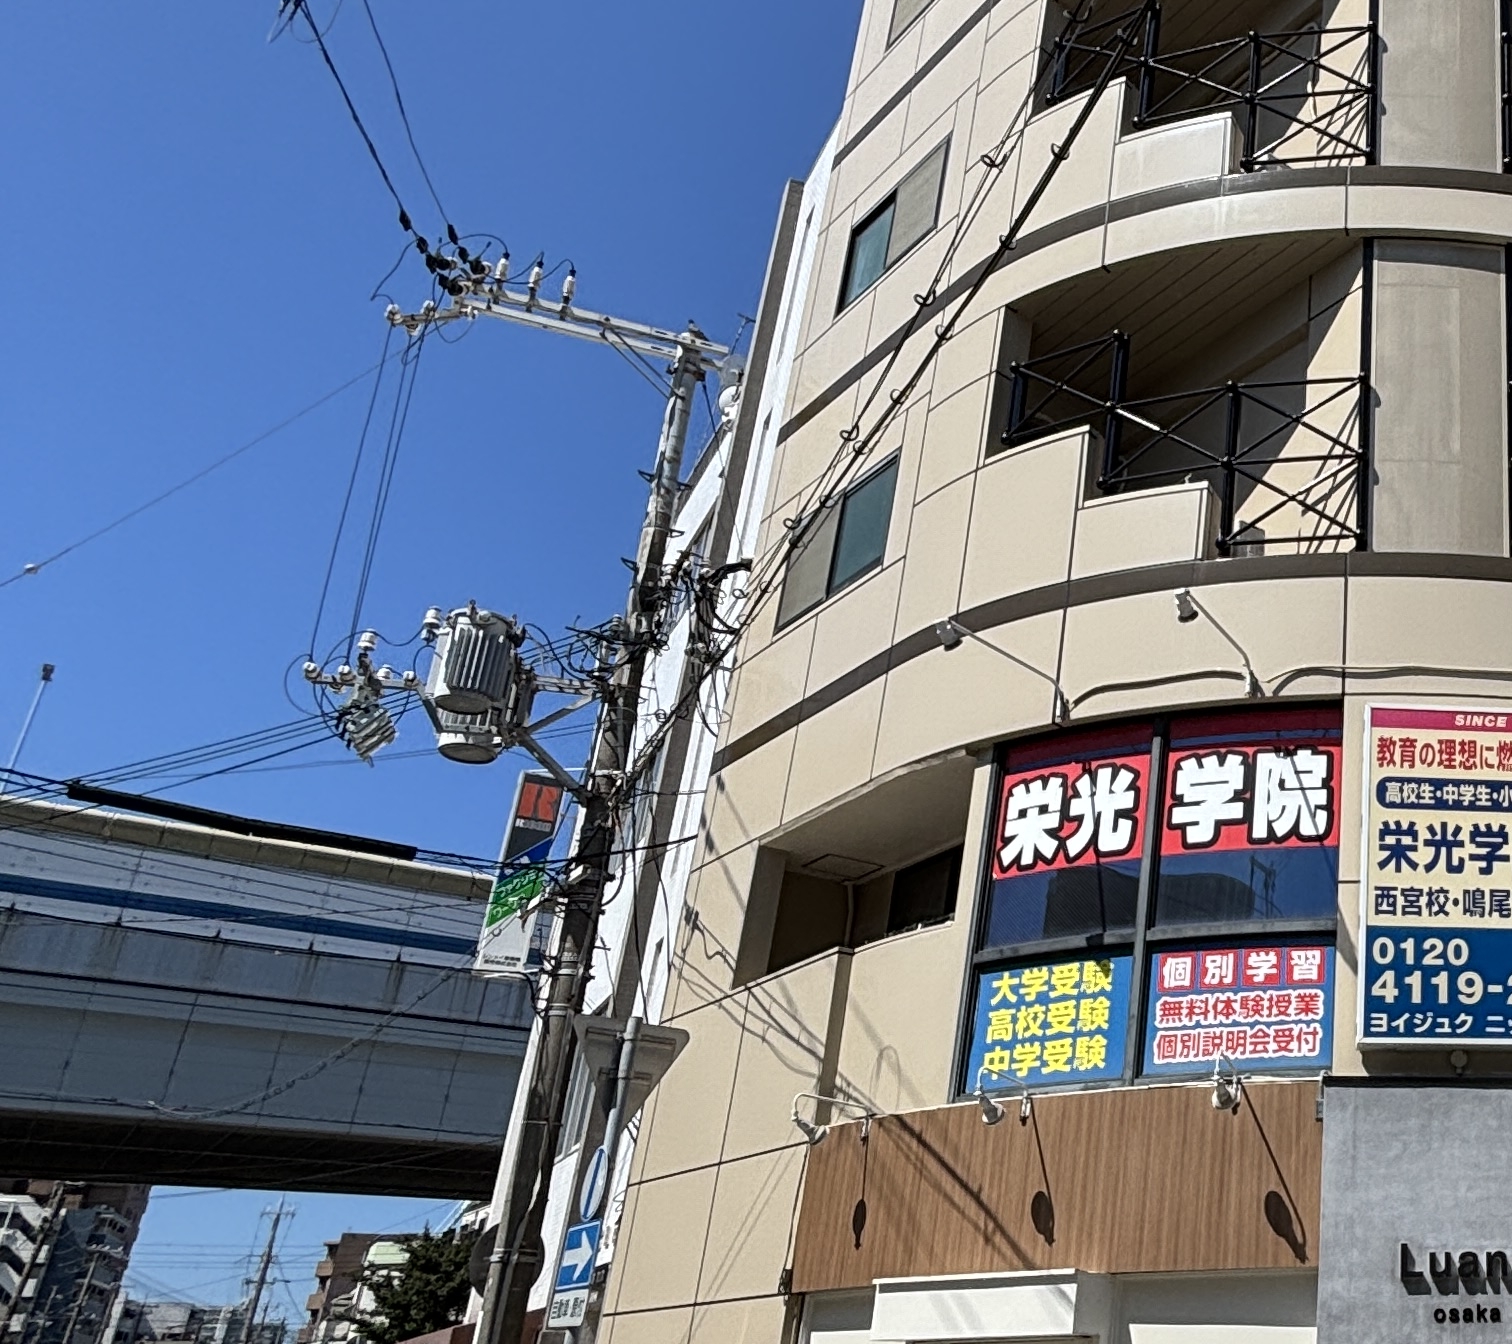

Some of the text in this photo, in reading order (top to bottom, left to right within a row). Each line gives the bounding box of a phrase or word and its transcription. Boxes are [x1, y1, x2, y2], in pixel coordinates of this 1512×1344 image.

[1454, 714, 1508, 728] SINCE
[1372, 936, 1470, 966] 0120
[990, 959, 1115, 1006] 大学受験
[1162, 950, 1322, 988] 個別学習
[985, 997, 1110, 1044] 高校受験
[1157, 992, 1322, 1024] 無料体験授業
[1369, 1012, 1473, 1034] ヨイジュク
[983, 1034, 1108, 1081] 中学受験
[1156, 1027, 1319, 1061] 個別説明会受付
[1433, 1303, 1503, 1324] osaka
